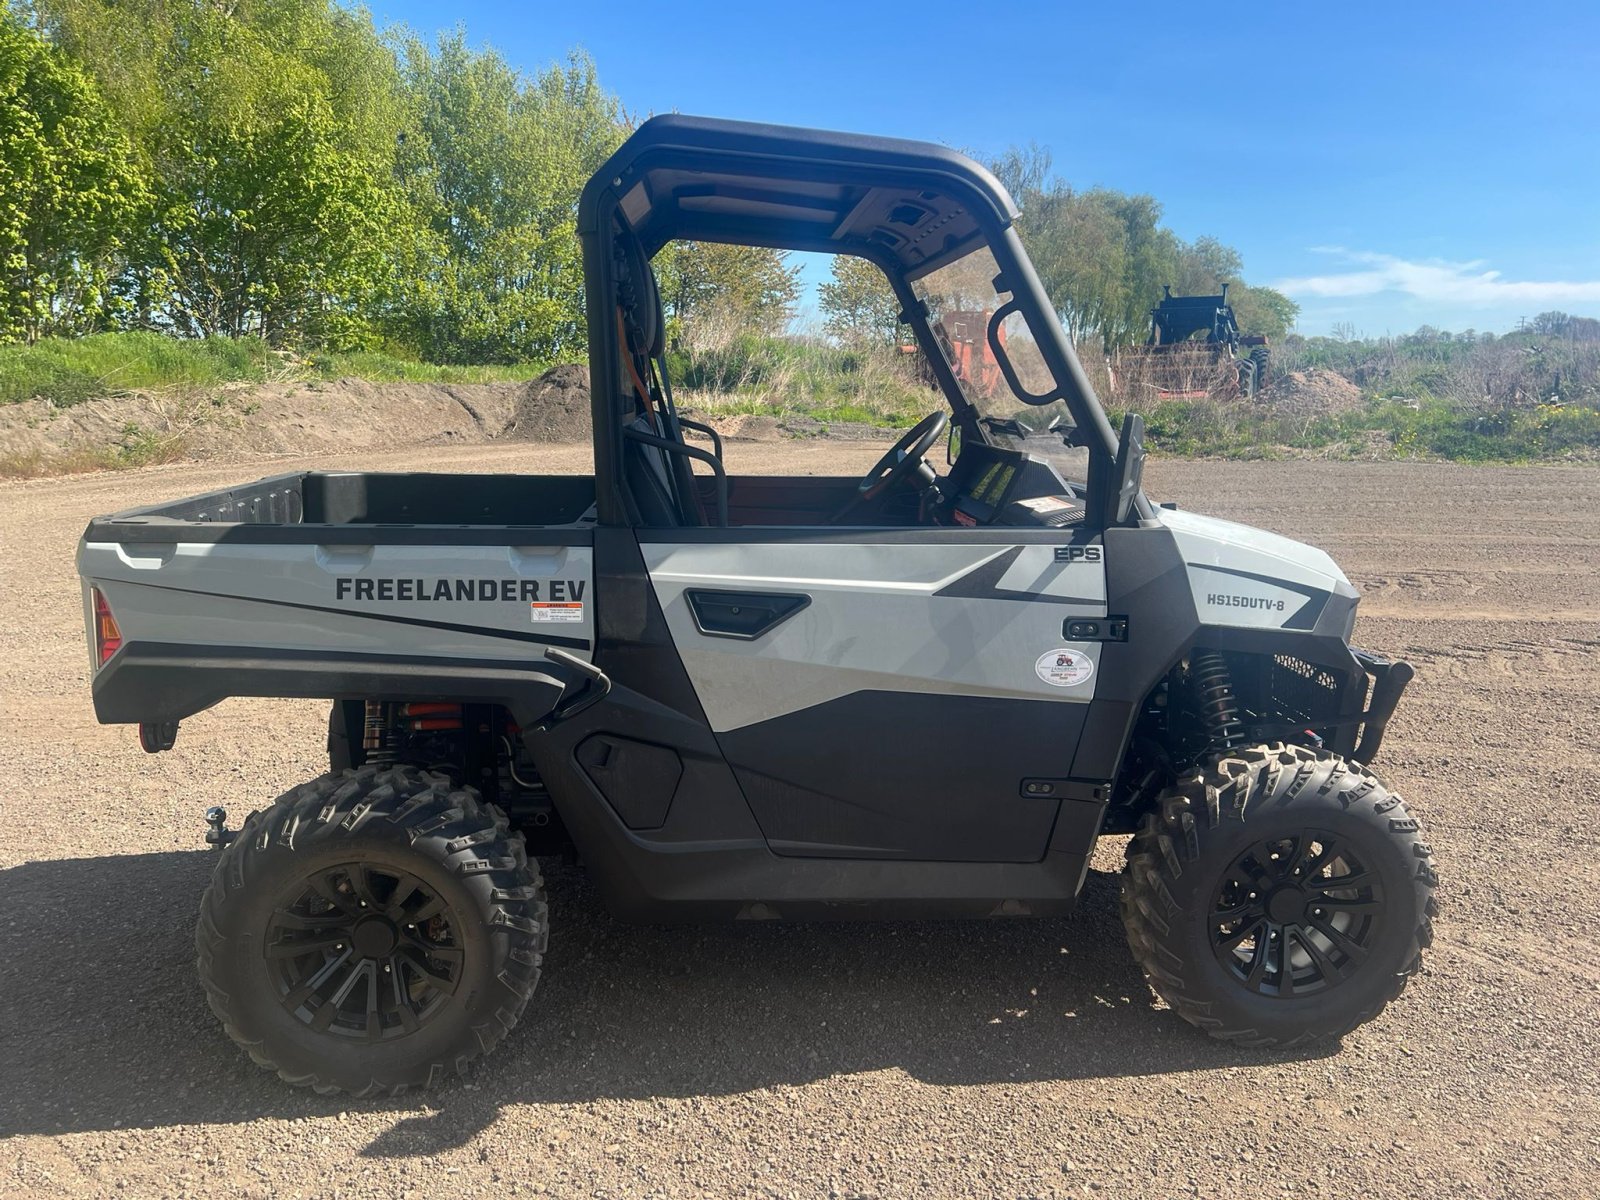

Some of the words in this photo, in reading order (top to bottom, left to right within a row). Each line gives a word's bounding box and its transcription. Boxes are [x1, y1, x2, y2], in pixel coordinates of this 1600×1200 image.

[1054, 547, 1101, 560] EPS
[336, 578, 541, 602] FREELANDER
[550, 580, 586, 602] EV
[1207, 593, 1285, 611] HS15DUTV-8
